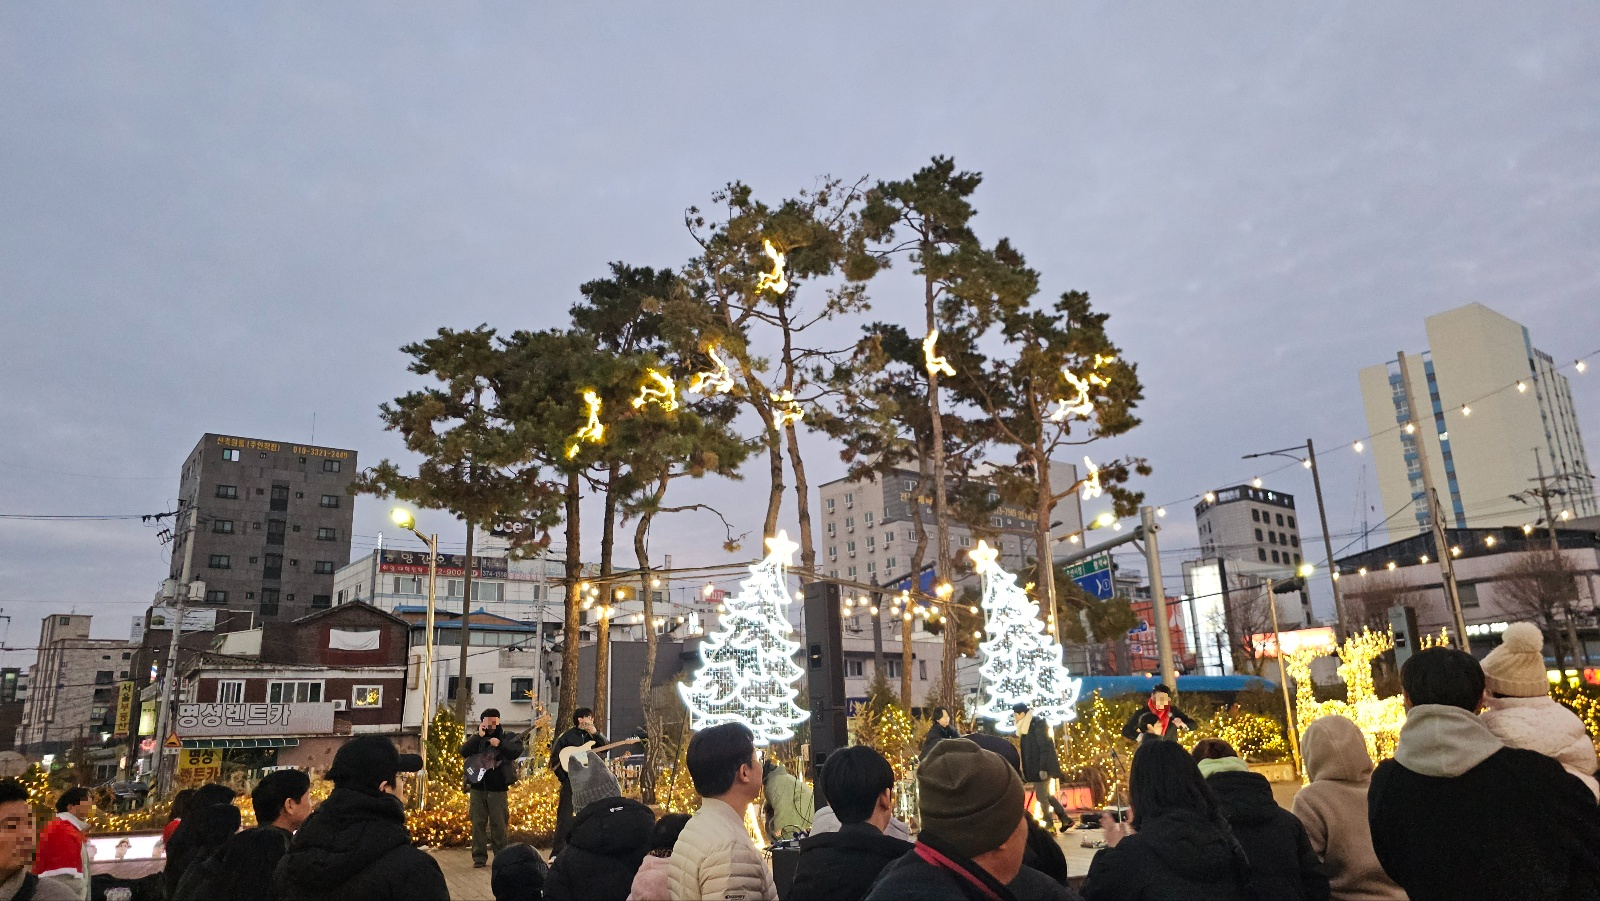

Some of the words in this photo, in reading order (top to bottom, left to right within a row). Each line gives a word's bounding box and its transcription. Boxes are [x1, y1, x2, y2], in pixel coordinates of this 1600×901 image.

[118, 684, 131, 731] 서울부동산
[178, 703, 291, 728] 명성렌트카
[189, 749, 214, 765] 명성
